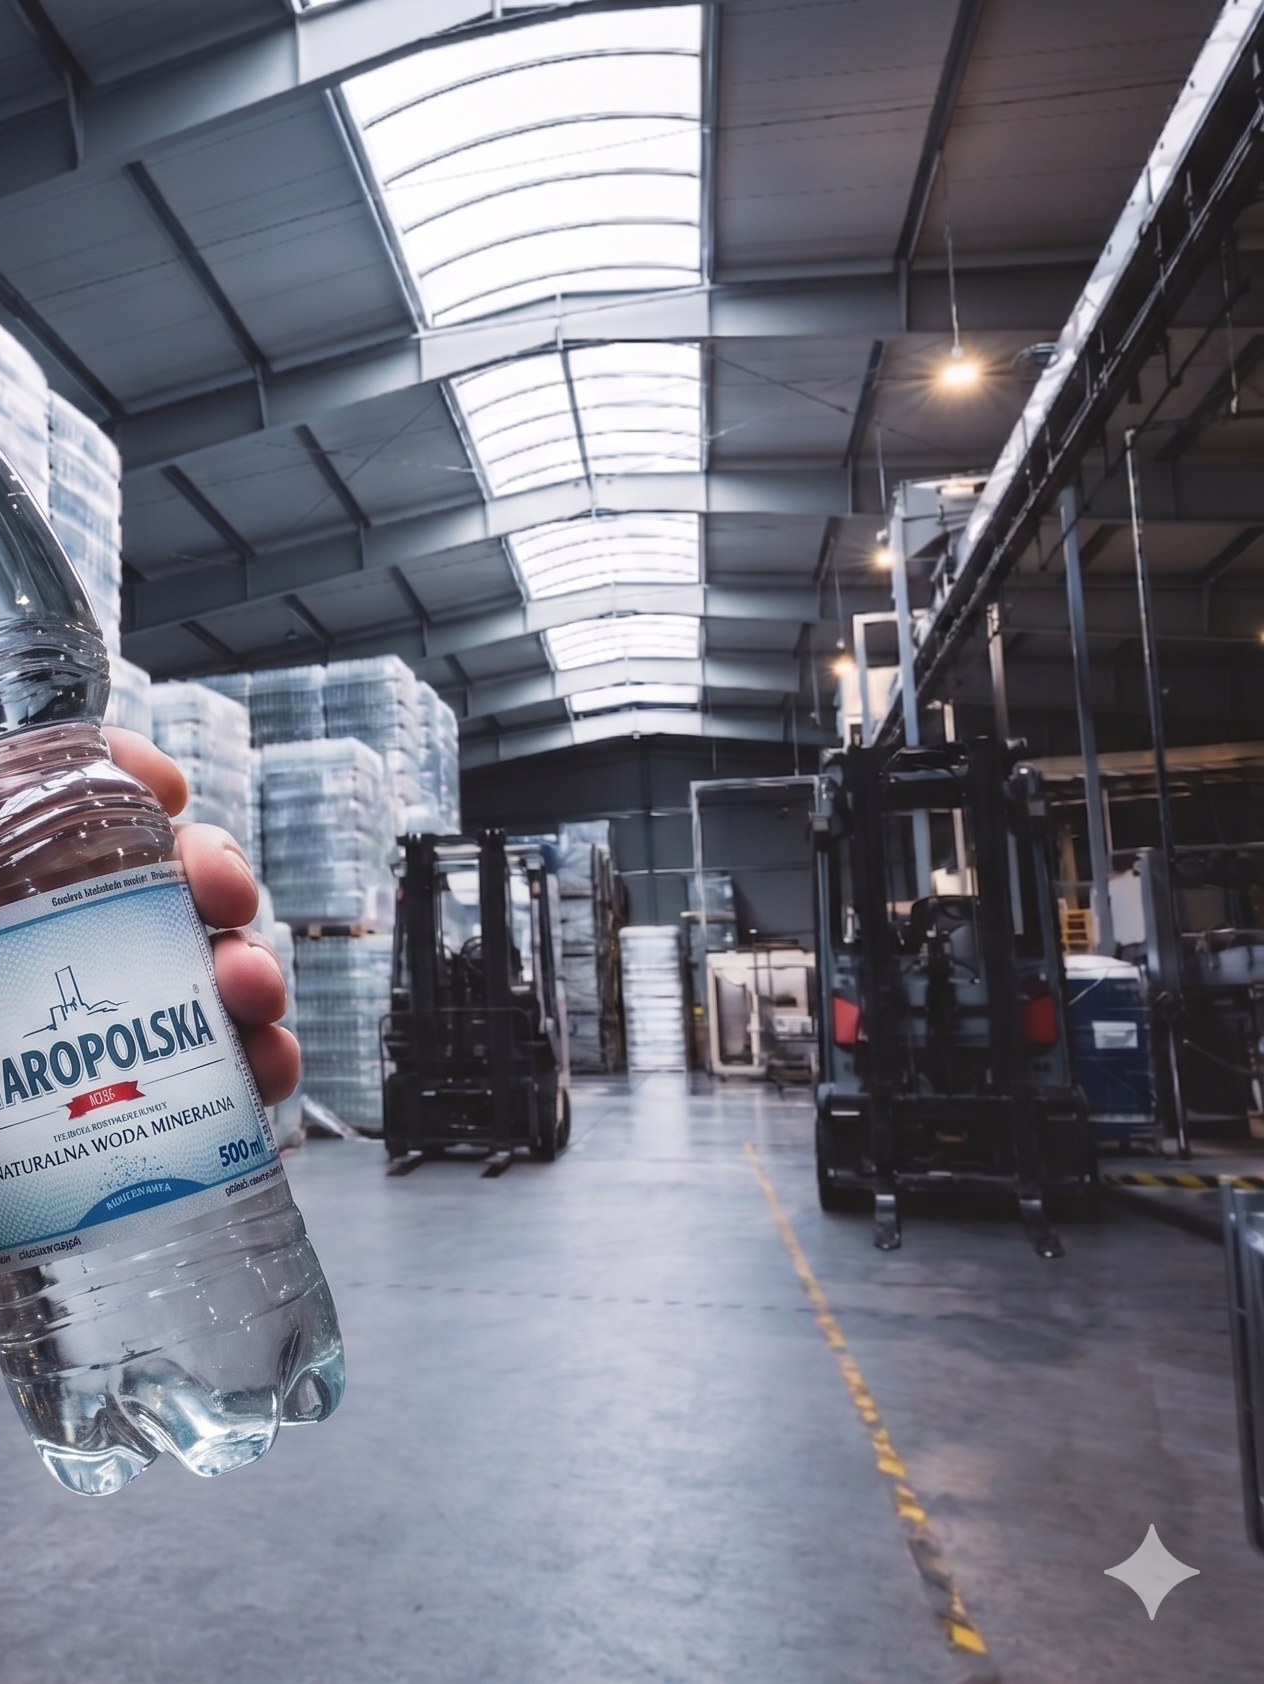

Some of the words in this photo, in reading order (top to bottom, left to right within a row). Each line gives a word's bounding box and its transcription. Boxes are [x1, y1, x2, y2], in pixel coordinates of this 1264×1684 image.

[91, 1124, 149, 1153] WODA
[152, 1096, 235, 1135] MINERALNA
[219, 1138, 249, 1167] 500
[250, 1135, 264, 1157] ml
